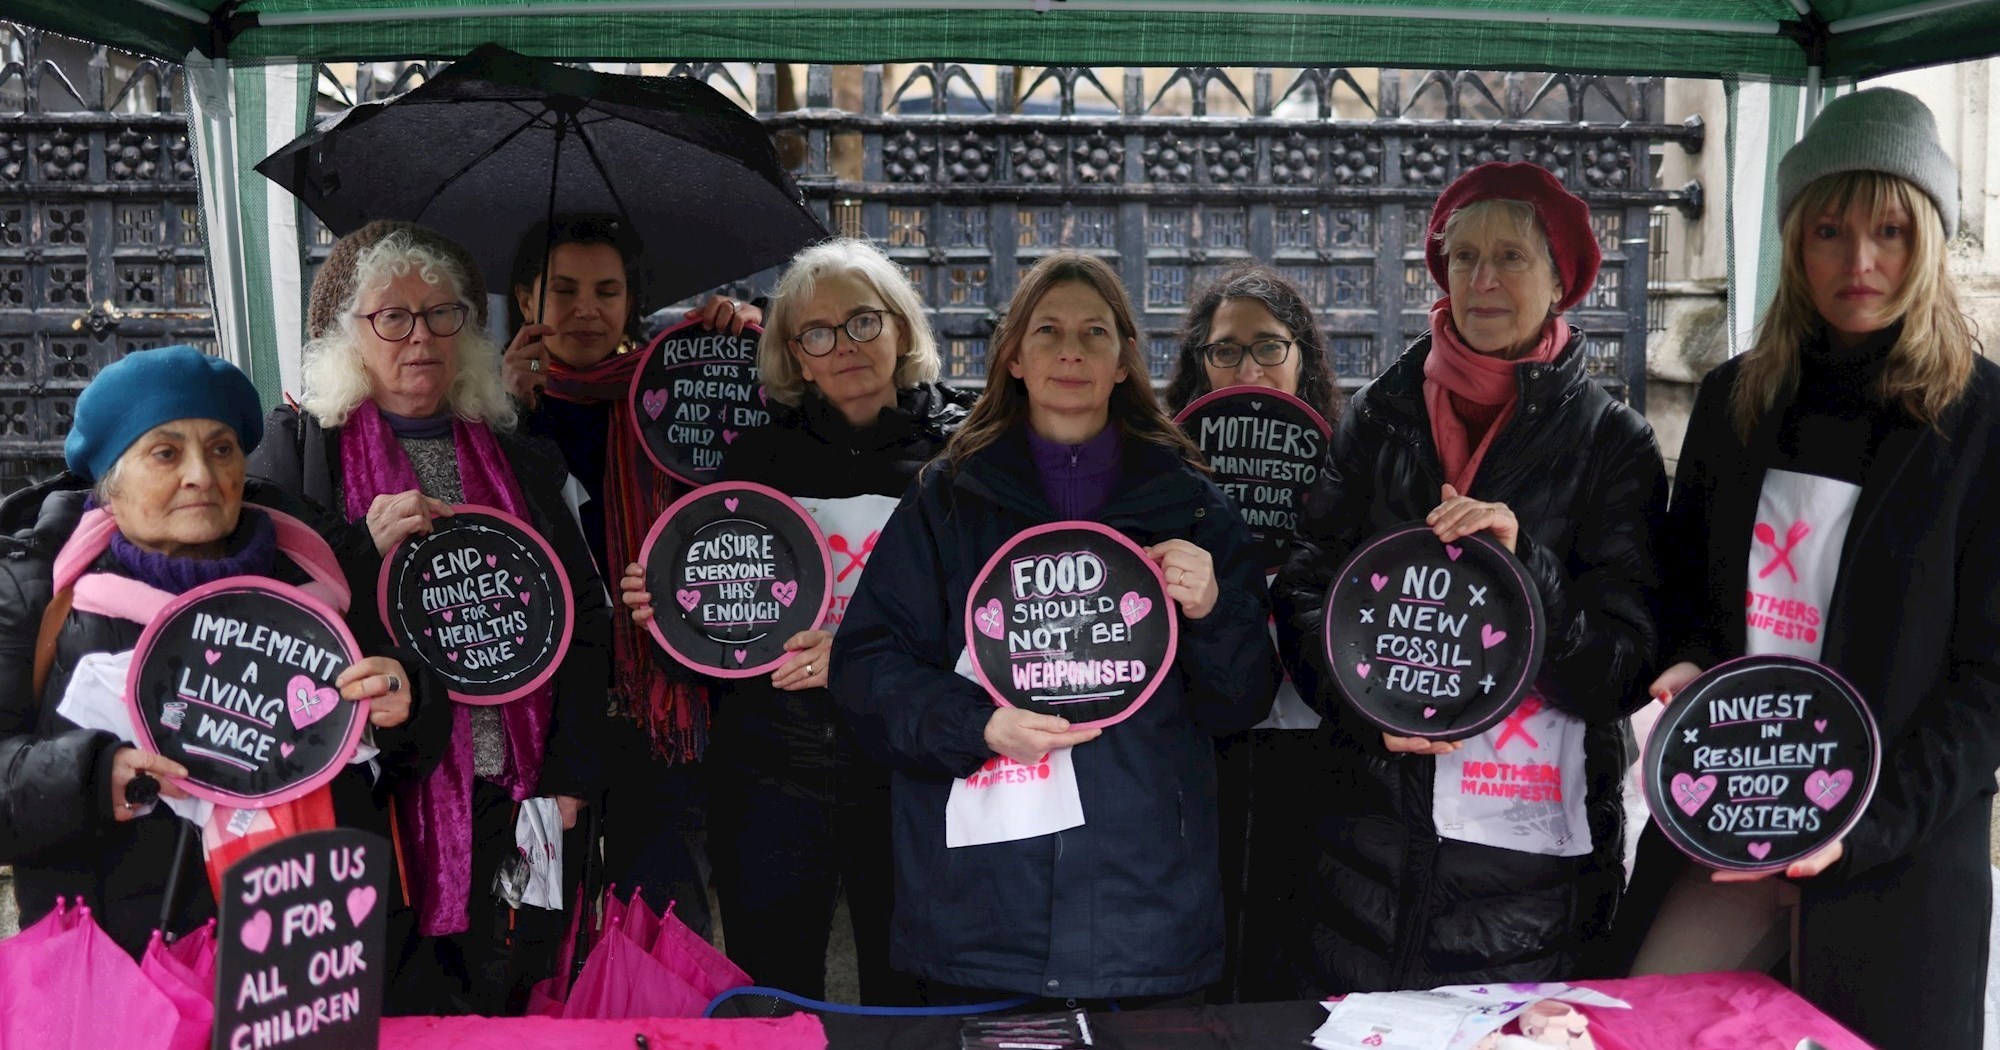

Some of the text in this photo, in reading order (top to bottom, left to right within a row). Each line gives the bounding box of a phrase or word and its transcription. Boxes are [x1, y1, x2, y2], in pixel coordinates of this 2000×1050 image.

[663, 335, 755, 366] REVERSE
[703, 363, 739, 379] CUTS
[673, 379, 752, 402] FOREIGN
[674, 402, 710, 422] AID
[733, 407, 770, 428] END
[667, 423, 715, 447] CHILD
[1200, 415, 1320, 460] MOTHERS
[1210, 455, 1317, 485] MANIFESTO
[1253, 485, 1293, 508] OUR
[431, 547, 482, 579] END
[686, 533, 775, 563] ENSURE
[684, 563, 776, 582] EVERYONE
[1012, 553, 1105, 598] FOOD
[1401, 565, 1451, 600] NO
[422, 569, 515, 611] HUNGER
[718, 582, 755, 600] HAS
[461, 604, 491, 622] FOR
[703, 601, 780, 622] ENOUGH
[1012, 596, 1115, 624] SHOULD
[1387, 604, 1468, 638] NEW
[1744, 590, 1820, 627] OTHERS
[1008, 623, 1126, 653] NOT BE
[1745, 612, 1817, 643] NIFESTO
[191, 613, 343, 681] IMPLEMENT
[463, 640, 515, 670] SAKE
[1376, 634, 1472, 667] FOSSIL
[241, 662, 259, 684] A
[1011, 659, 1147, 691] WEAPONISED
[1386, 666, 1461, 698] FUELS
[177, 667, 284, 726] LIVING
[1708, 693, 1812, 724] INVEST
[196, 713, 276, 762] WAGE
[1760, 722, 1783, 739] IN
[1693, 741, 1838, 769] RESILIENT
[1462, 761, 1561, 787] MOTHERS
[1727, 774, 1789, 798] FOOD
[1461, 780, 1563, 802] MANIFESTO
[1707, 805, 1821, 832] SYSTEMS
[241, 846, 366, 903] JOIN US
[282, 899, 335, 945] FOR
[236, 941, 367, 1012] ALL OUR
[230, 987, 360, 1050] CHILDREN
